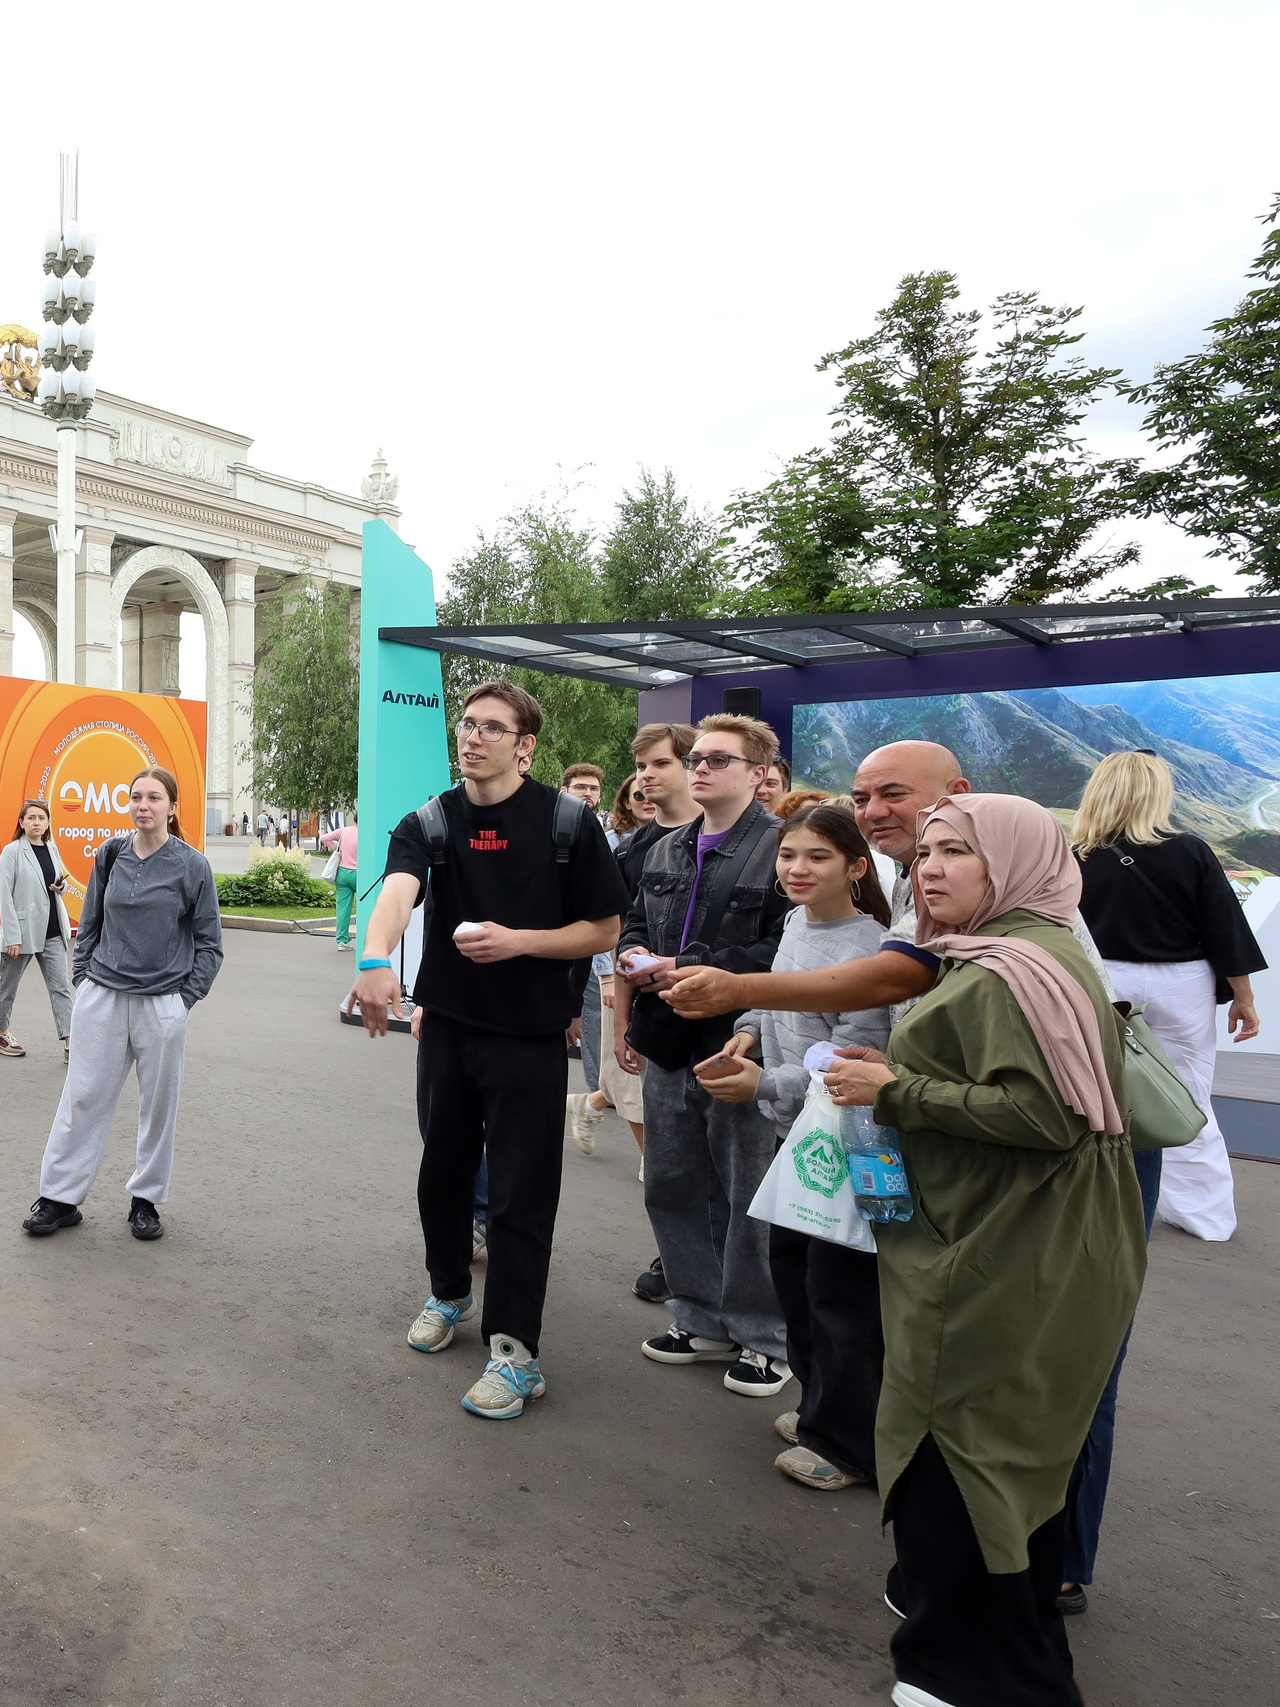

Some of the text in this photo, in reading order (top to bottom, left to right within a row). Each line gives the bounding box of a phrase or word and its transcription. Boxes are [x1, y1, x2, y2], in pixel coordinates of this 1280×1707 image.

[382, 690, 439, 708] АЛТАЙ
[54, 720, 159, 767] МОЛОДЁЖНАЯ СТОЛИЦА РОССИИ-202
[60, 780, 131, 815] ОМС
[59, 827, 137, 842] город по име
[478, 830, 497, 840] THE
[83, 844, 98, 858] Со
[469, 838, 508, 850] THERAPY
[811, 1168, 834, 1182] АЛТАЙ
